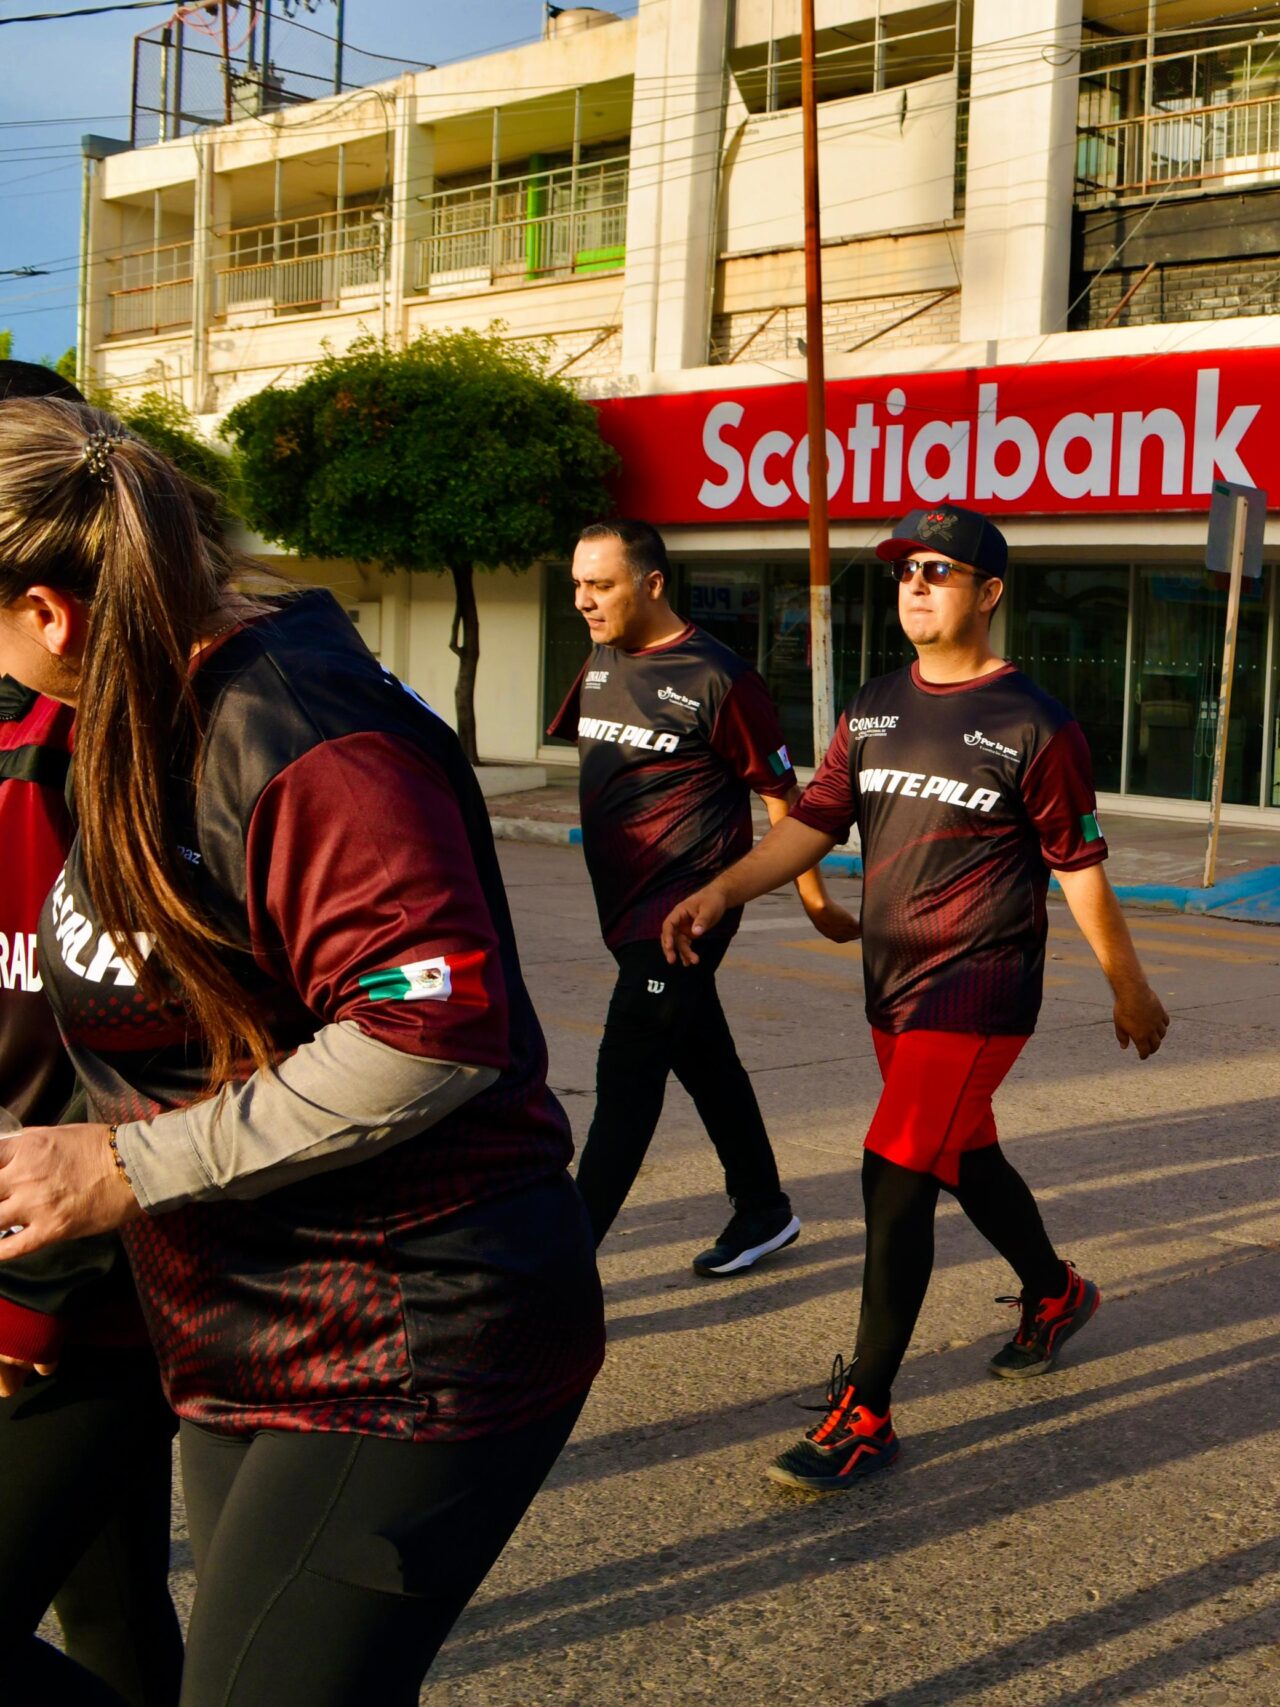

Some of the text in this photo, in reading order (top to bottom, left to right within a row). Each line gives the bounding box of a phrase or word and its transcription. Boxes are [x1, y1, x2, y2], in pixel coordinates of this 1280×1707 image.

[697, 368, 1262, 510] Scotiabank
[849, 715, 899, 732] CONADE
[617, 725, 680, 754] PILA
[980, 737, 1019, 757] Por la paz
[920, 775, 1001, 813] PILA
